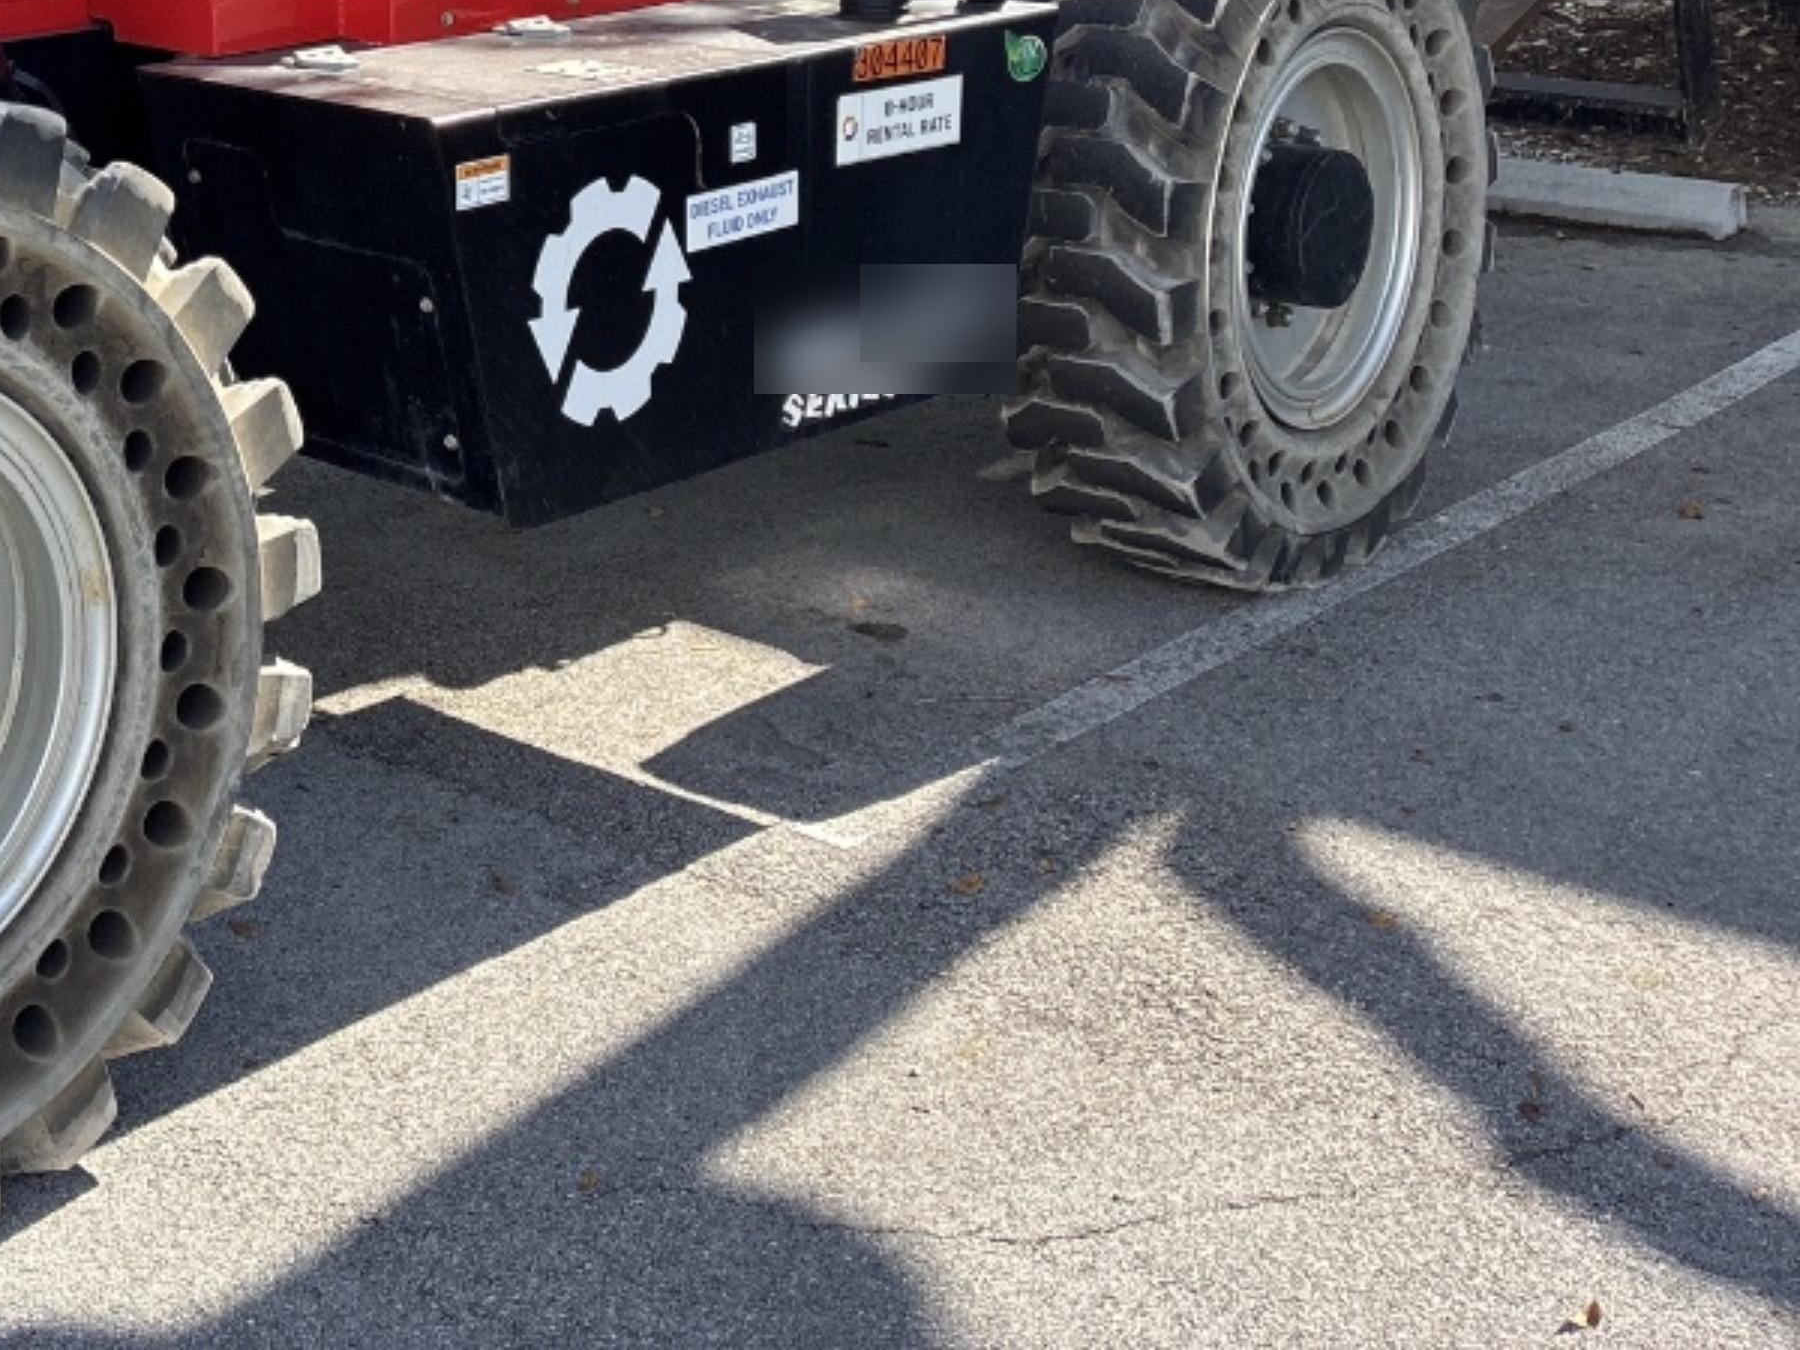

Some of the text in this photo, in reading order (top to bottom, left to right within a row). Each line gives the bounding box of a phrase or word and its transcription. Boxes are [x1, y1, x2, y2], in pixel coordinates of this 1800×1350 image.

[866, 113, 953, 146] RENTAL RATE
[689, 179, 794, 220] DIESEL EXHAUST
[707, 206, 778, 240] FLUID ONLY
